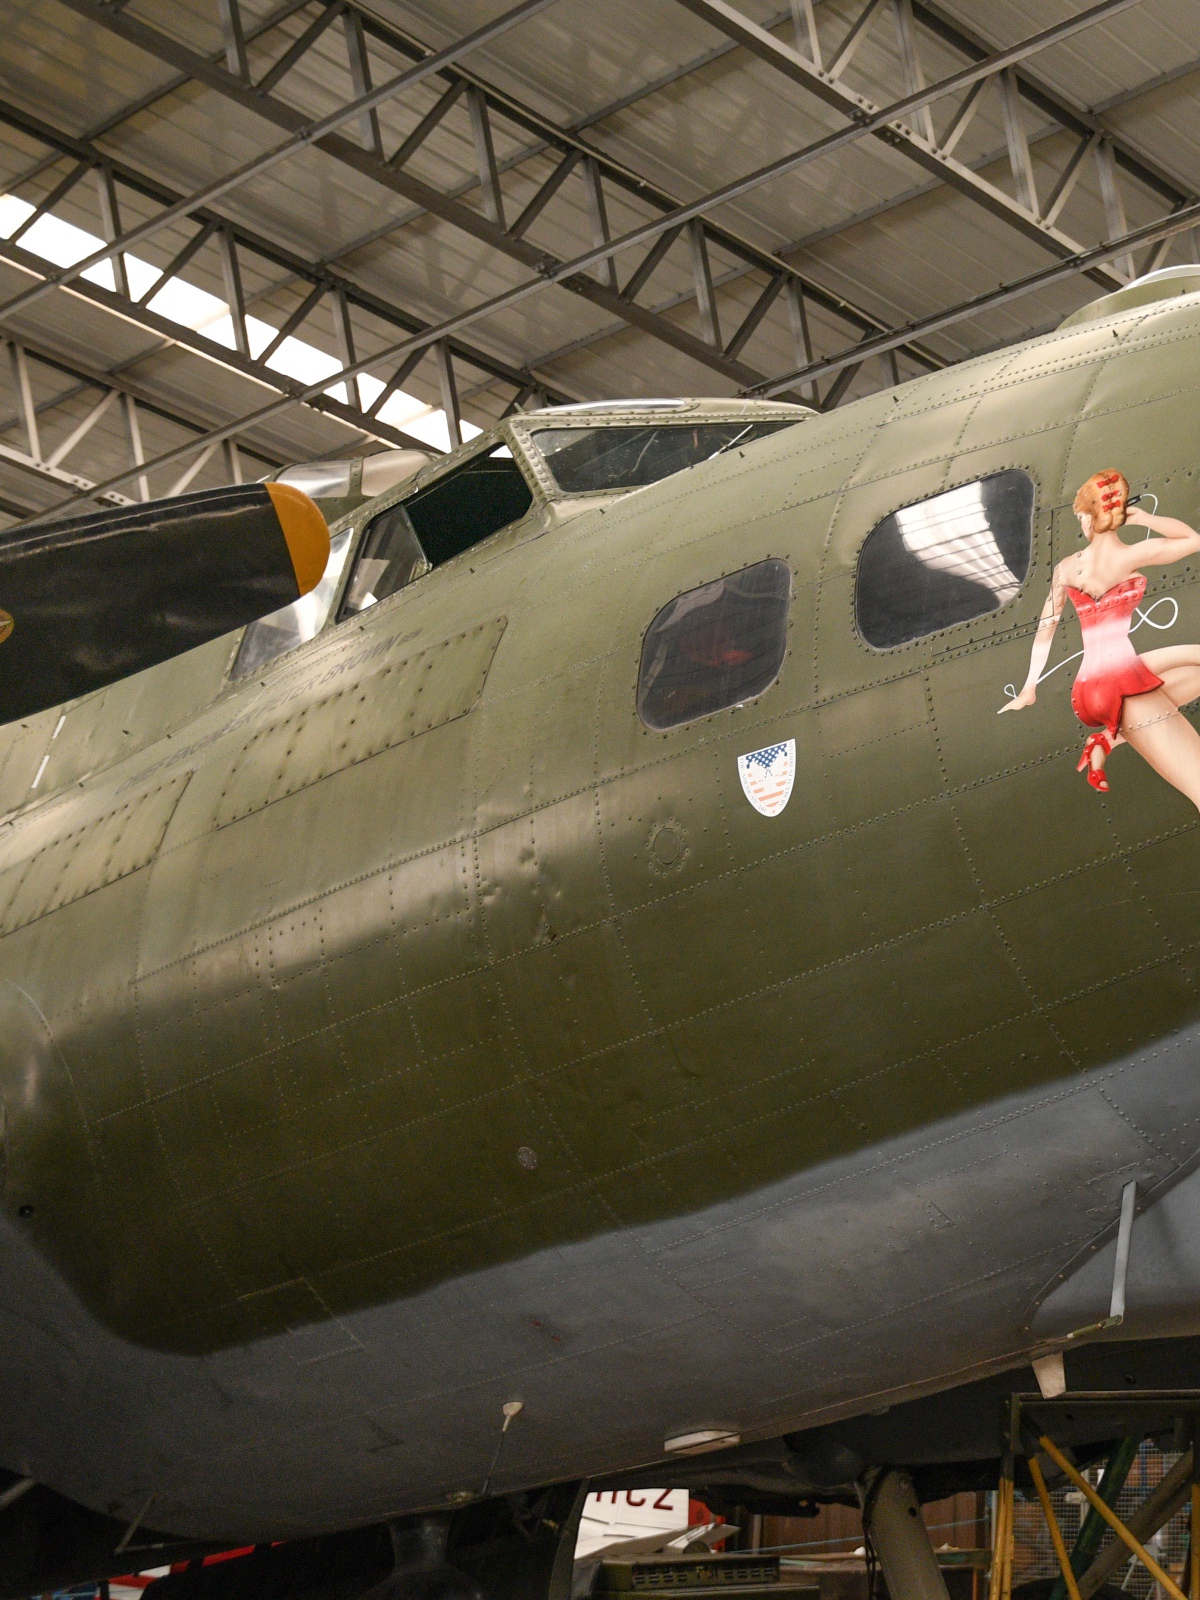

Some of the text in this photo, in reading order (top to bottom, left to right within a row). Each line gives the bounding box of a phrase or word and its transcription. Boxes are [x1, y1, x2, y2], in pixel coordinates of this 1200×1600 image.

[164, 706, 259, 768] ENGINEER
[255, 672, 322, 718] PETER
[318, 631, 402, 685] BROWN
